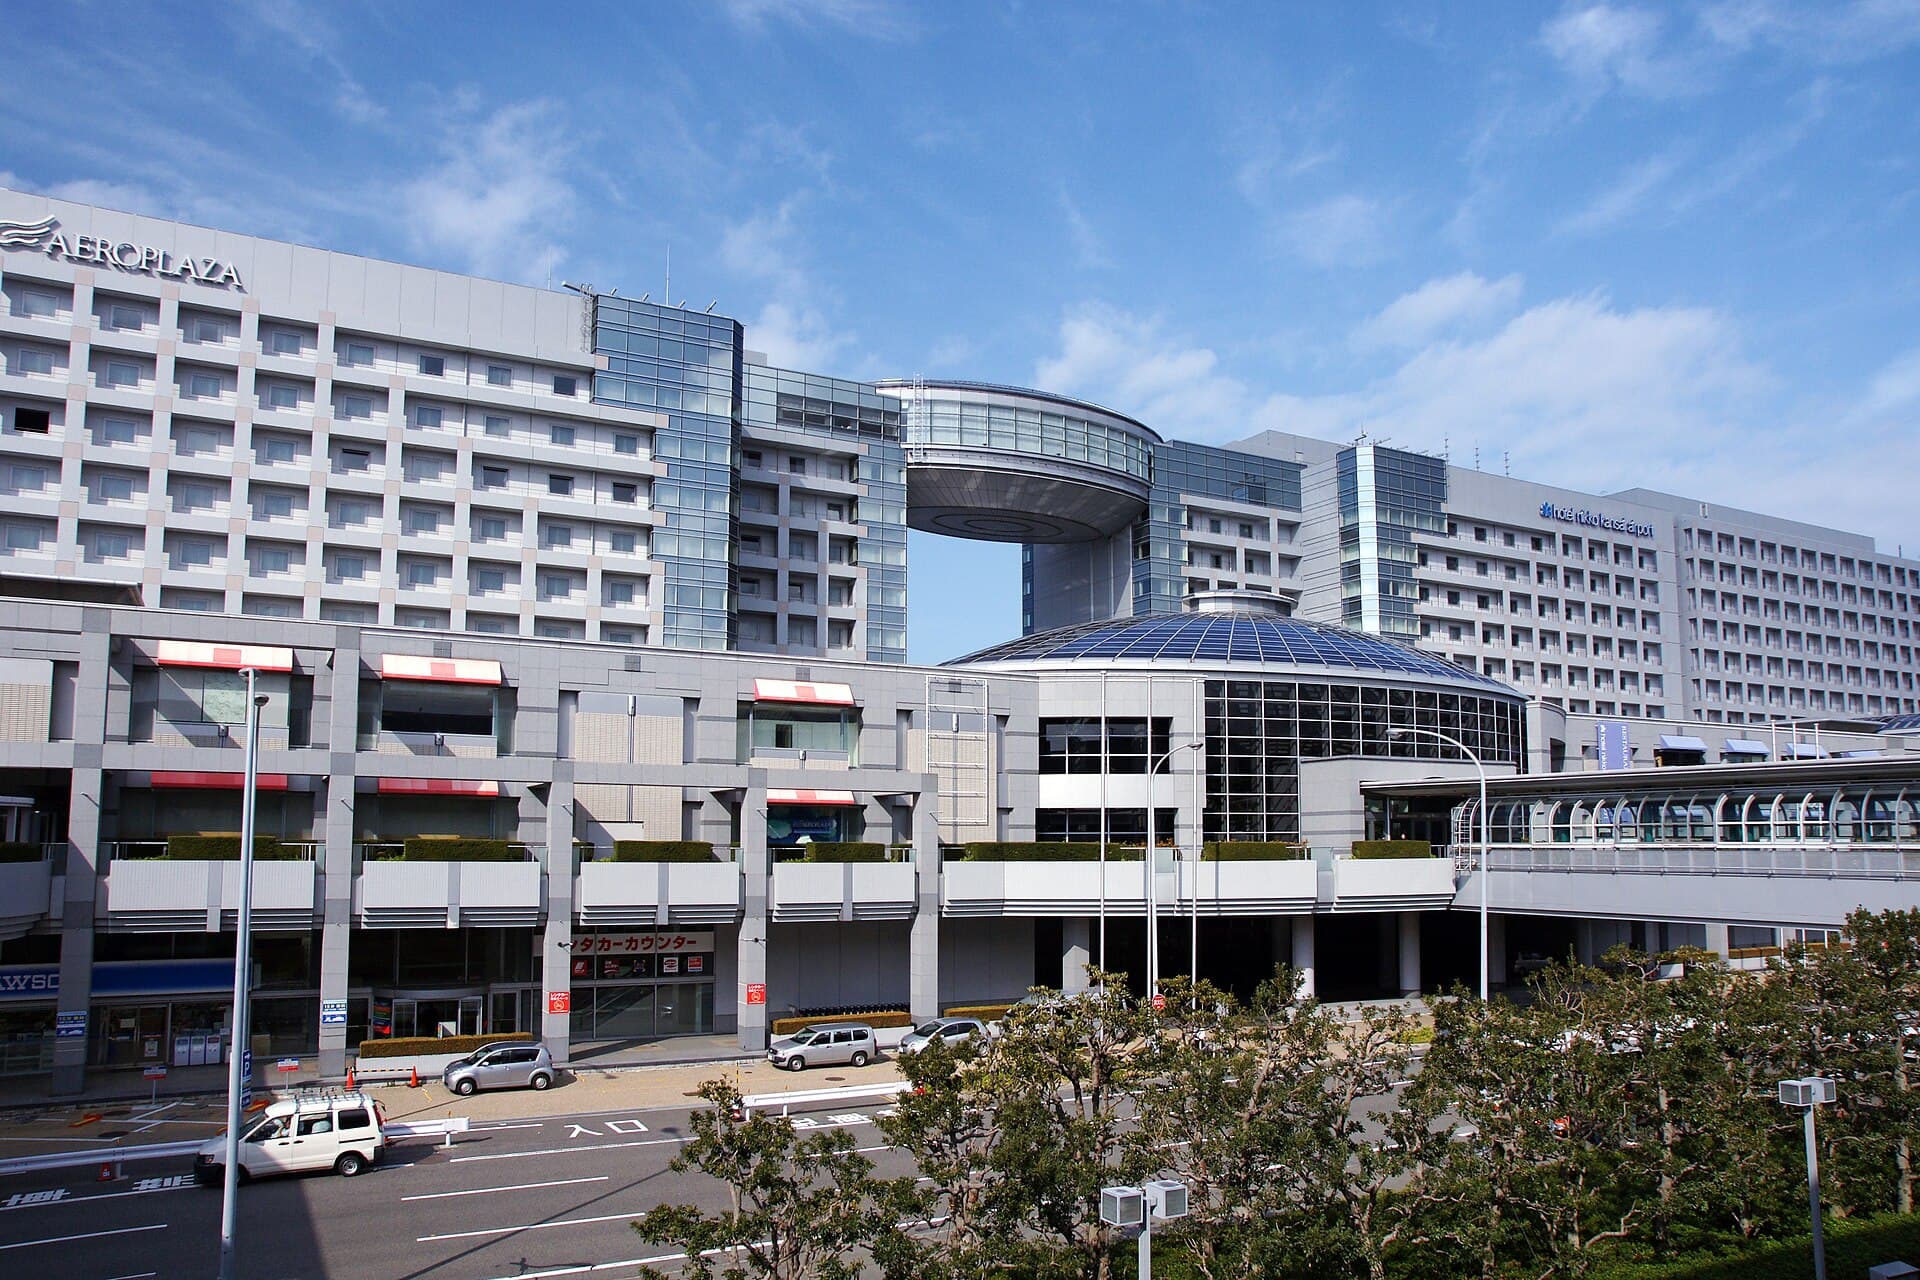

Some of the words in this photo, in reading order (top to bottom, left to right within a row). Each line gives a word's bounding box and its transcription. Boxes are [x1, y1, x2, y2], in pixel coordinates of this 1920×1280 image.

[43, 233, 243, 287] AEROPLAZA
[1551, 504, 1574, 521] hotel
[1576, 509, 1599, 527] nikko
[1621, 725, 1629, 769] RESTAURA
[0, 974, 60, 990] WSO
[563, 1119, 649, 1138] 入口
